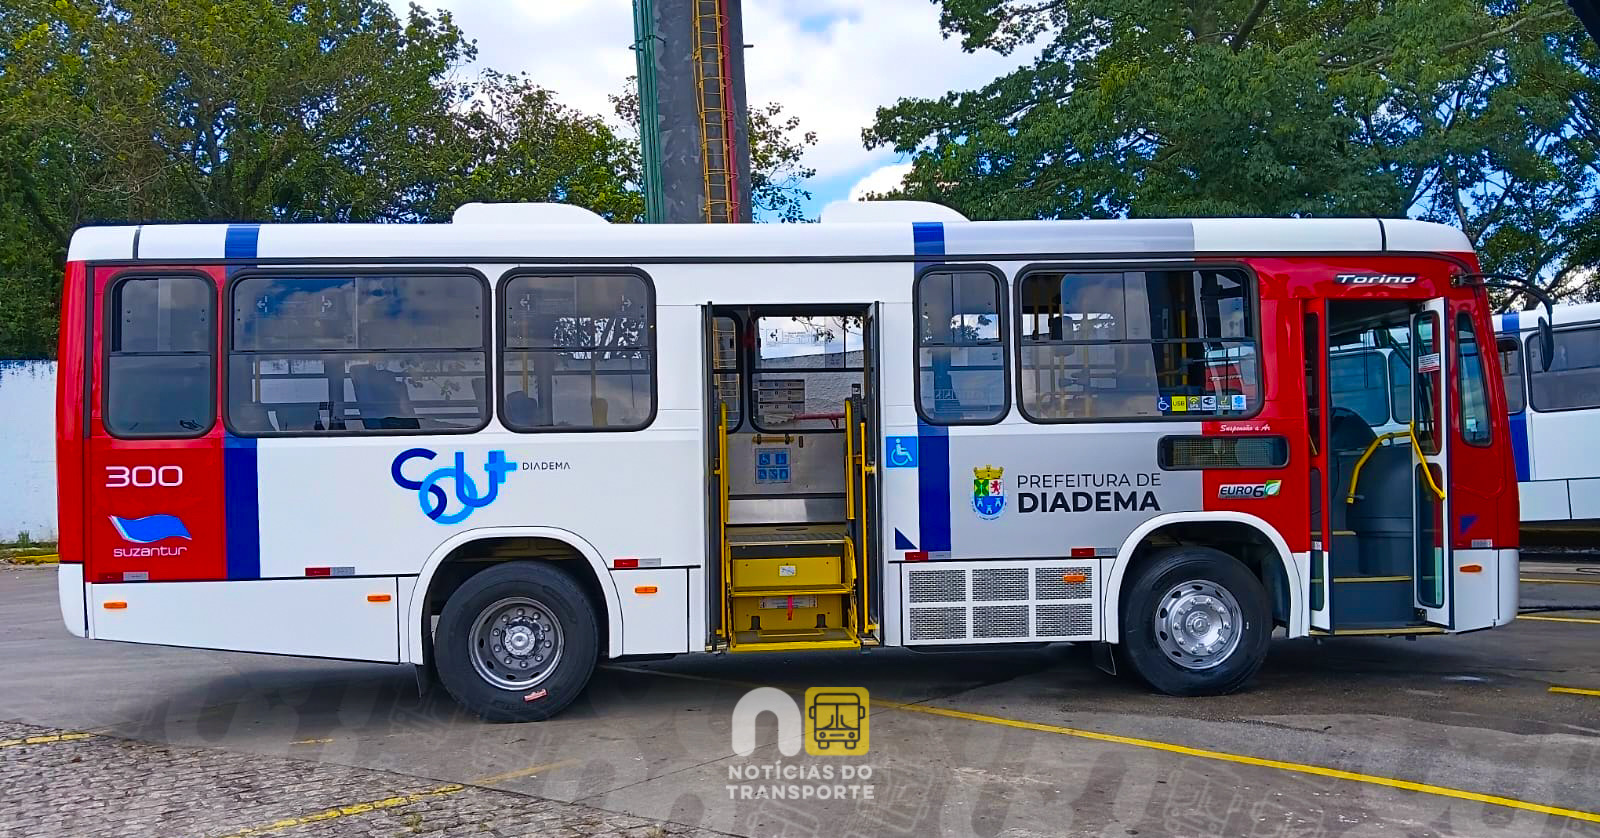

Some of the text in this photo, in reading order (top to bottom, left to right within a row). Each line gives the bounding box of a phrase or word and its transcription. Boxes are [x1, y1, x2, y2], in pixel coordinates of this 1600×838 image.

[1336, 274, 1417, 285] Torino
[522, 462, 571, 471] DIADEMA
[105, 465, 184, 487] 300
[1017, 472, 1162, 489] PREFEITURA DE
[1220, 485, 1265, 498] EURO6
[1017, 490, 1162, 514] DIADEMA
[113, 546, 188, 558] suzantur
